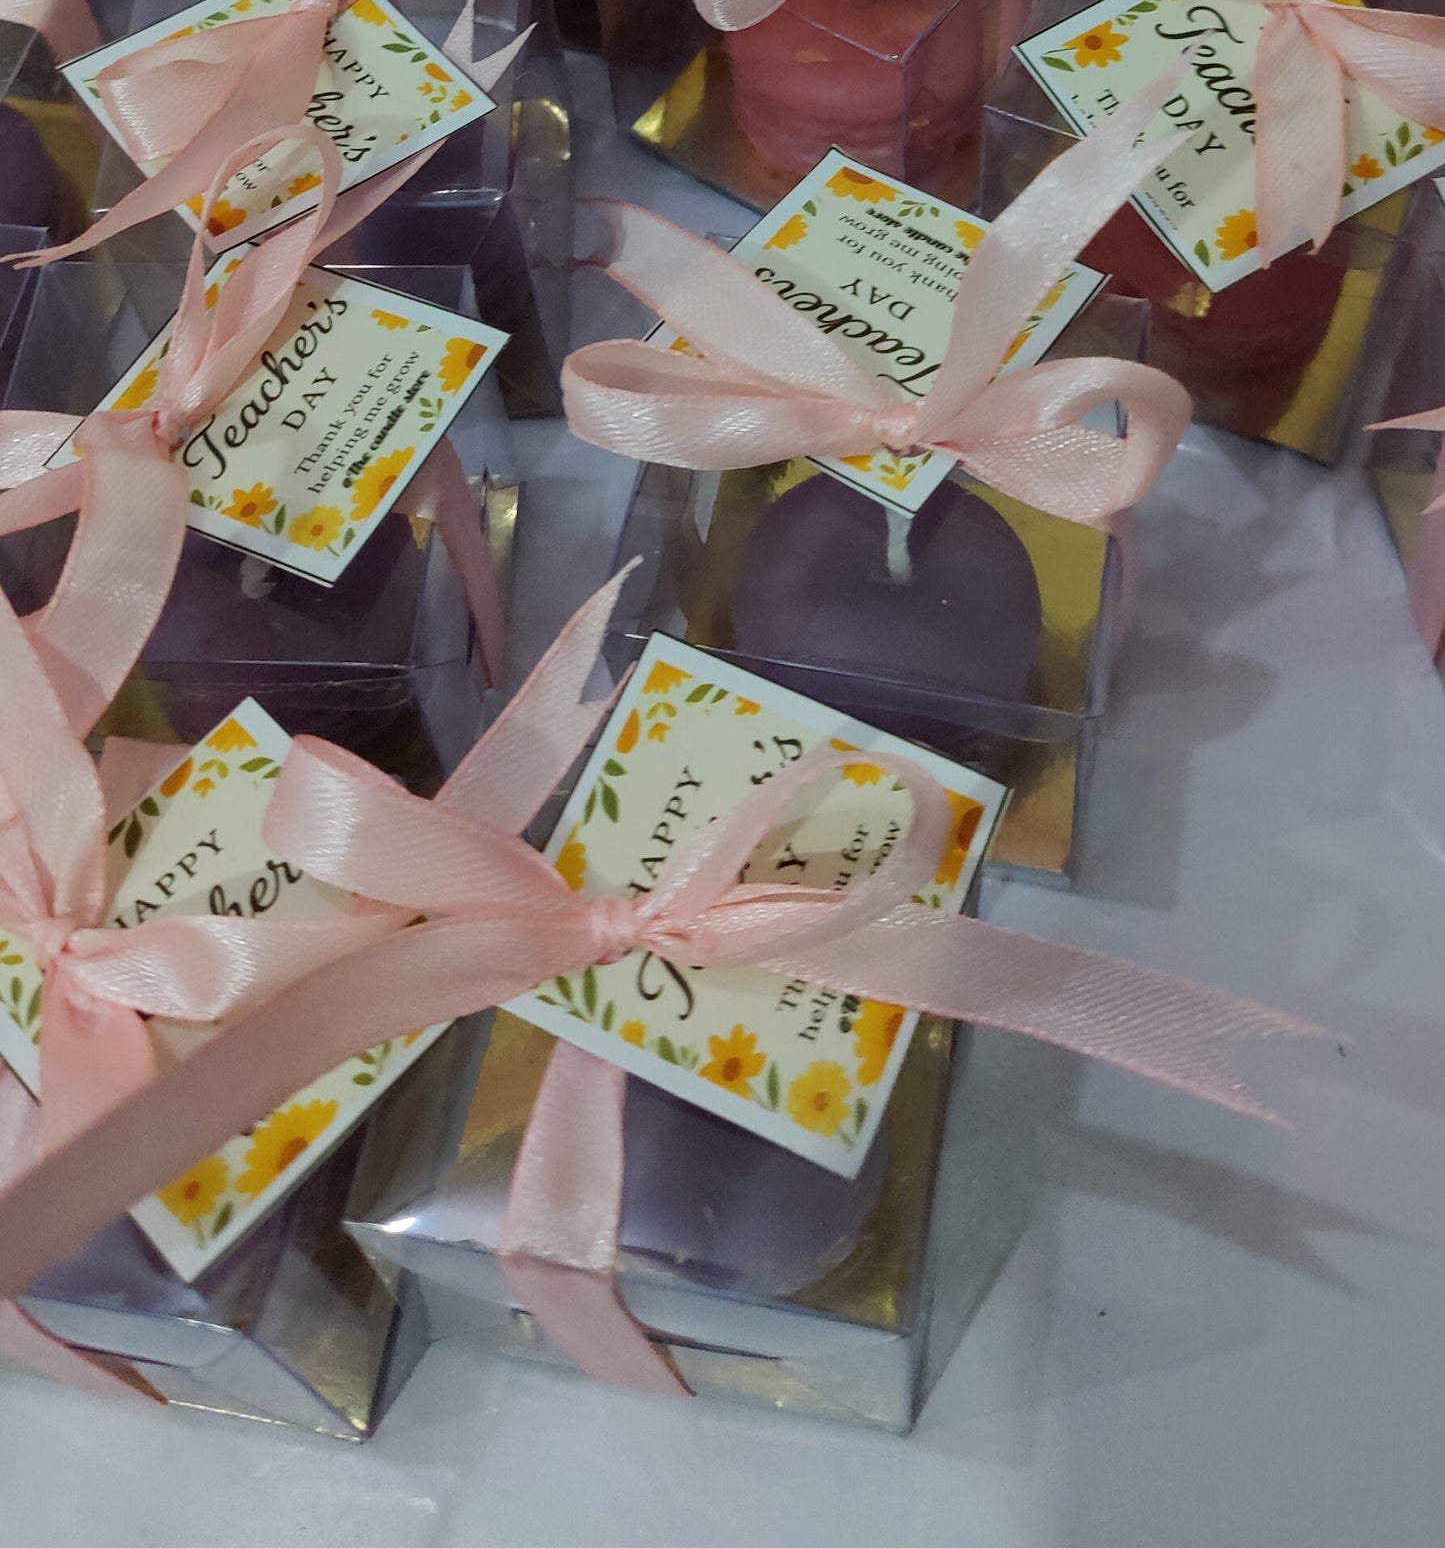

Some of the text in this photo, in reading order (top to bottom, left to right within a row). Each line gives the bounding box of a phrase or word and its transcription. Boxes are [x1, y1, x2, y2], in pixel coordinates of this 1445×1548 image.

[304, 91, 378, 163] her's
[235, 171, 258, 190] ow
[253, 159, 272, 172] or
[1167, 181, 1196, 209] for
[838, 215, 890, 241] grow
[888, 238, 920, 258] me
[903, 226, 955, 254] candle
[835, 234, 960, 303] hank you for
[838, 277, 917, 321] DAY
[754, 266, 943, 397] Teachers
[182, 297, 348, 480] Teacher's
[280, 366, 339, 433] DAY
[293, 352, 394, 474] Thank you for
[306, 350, 420, 494] helping me grow
[369, 403, 407, 451] candle
[839, 823, 869, 864] for
